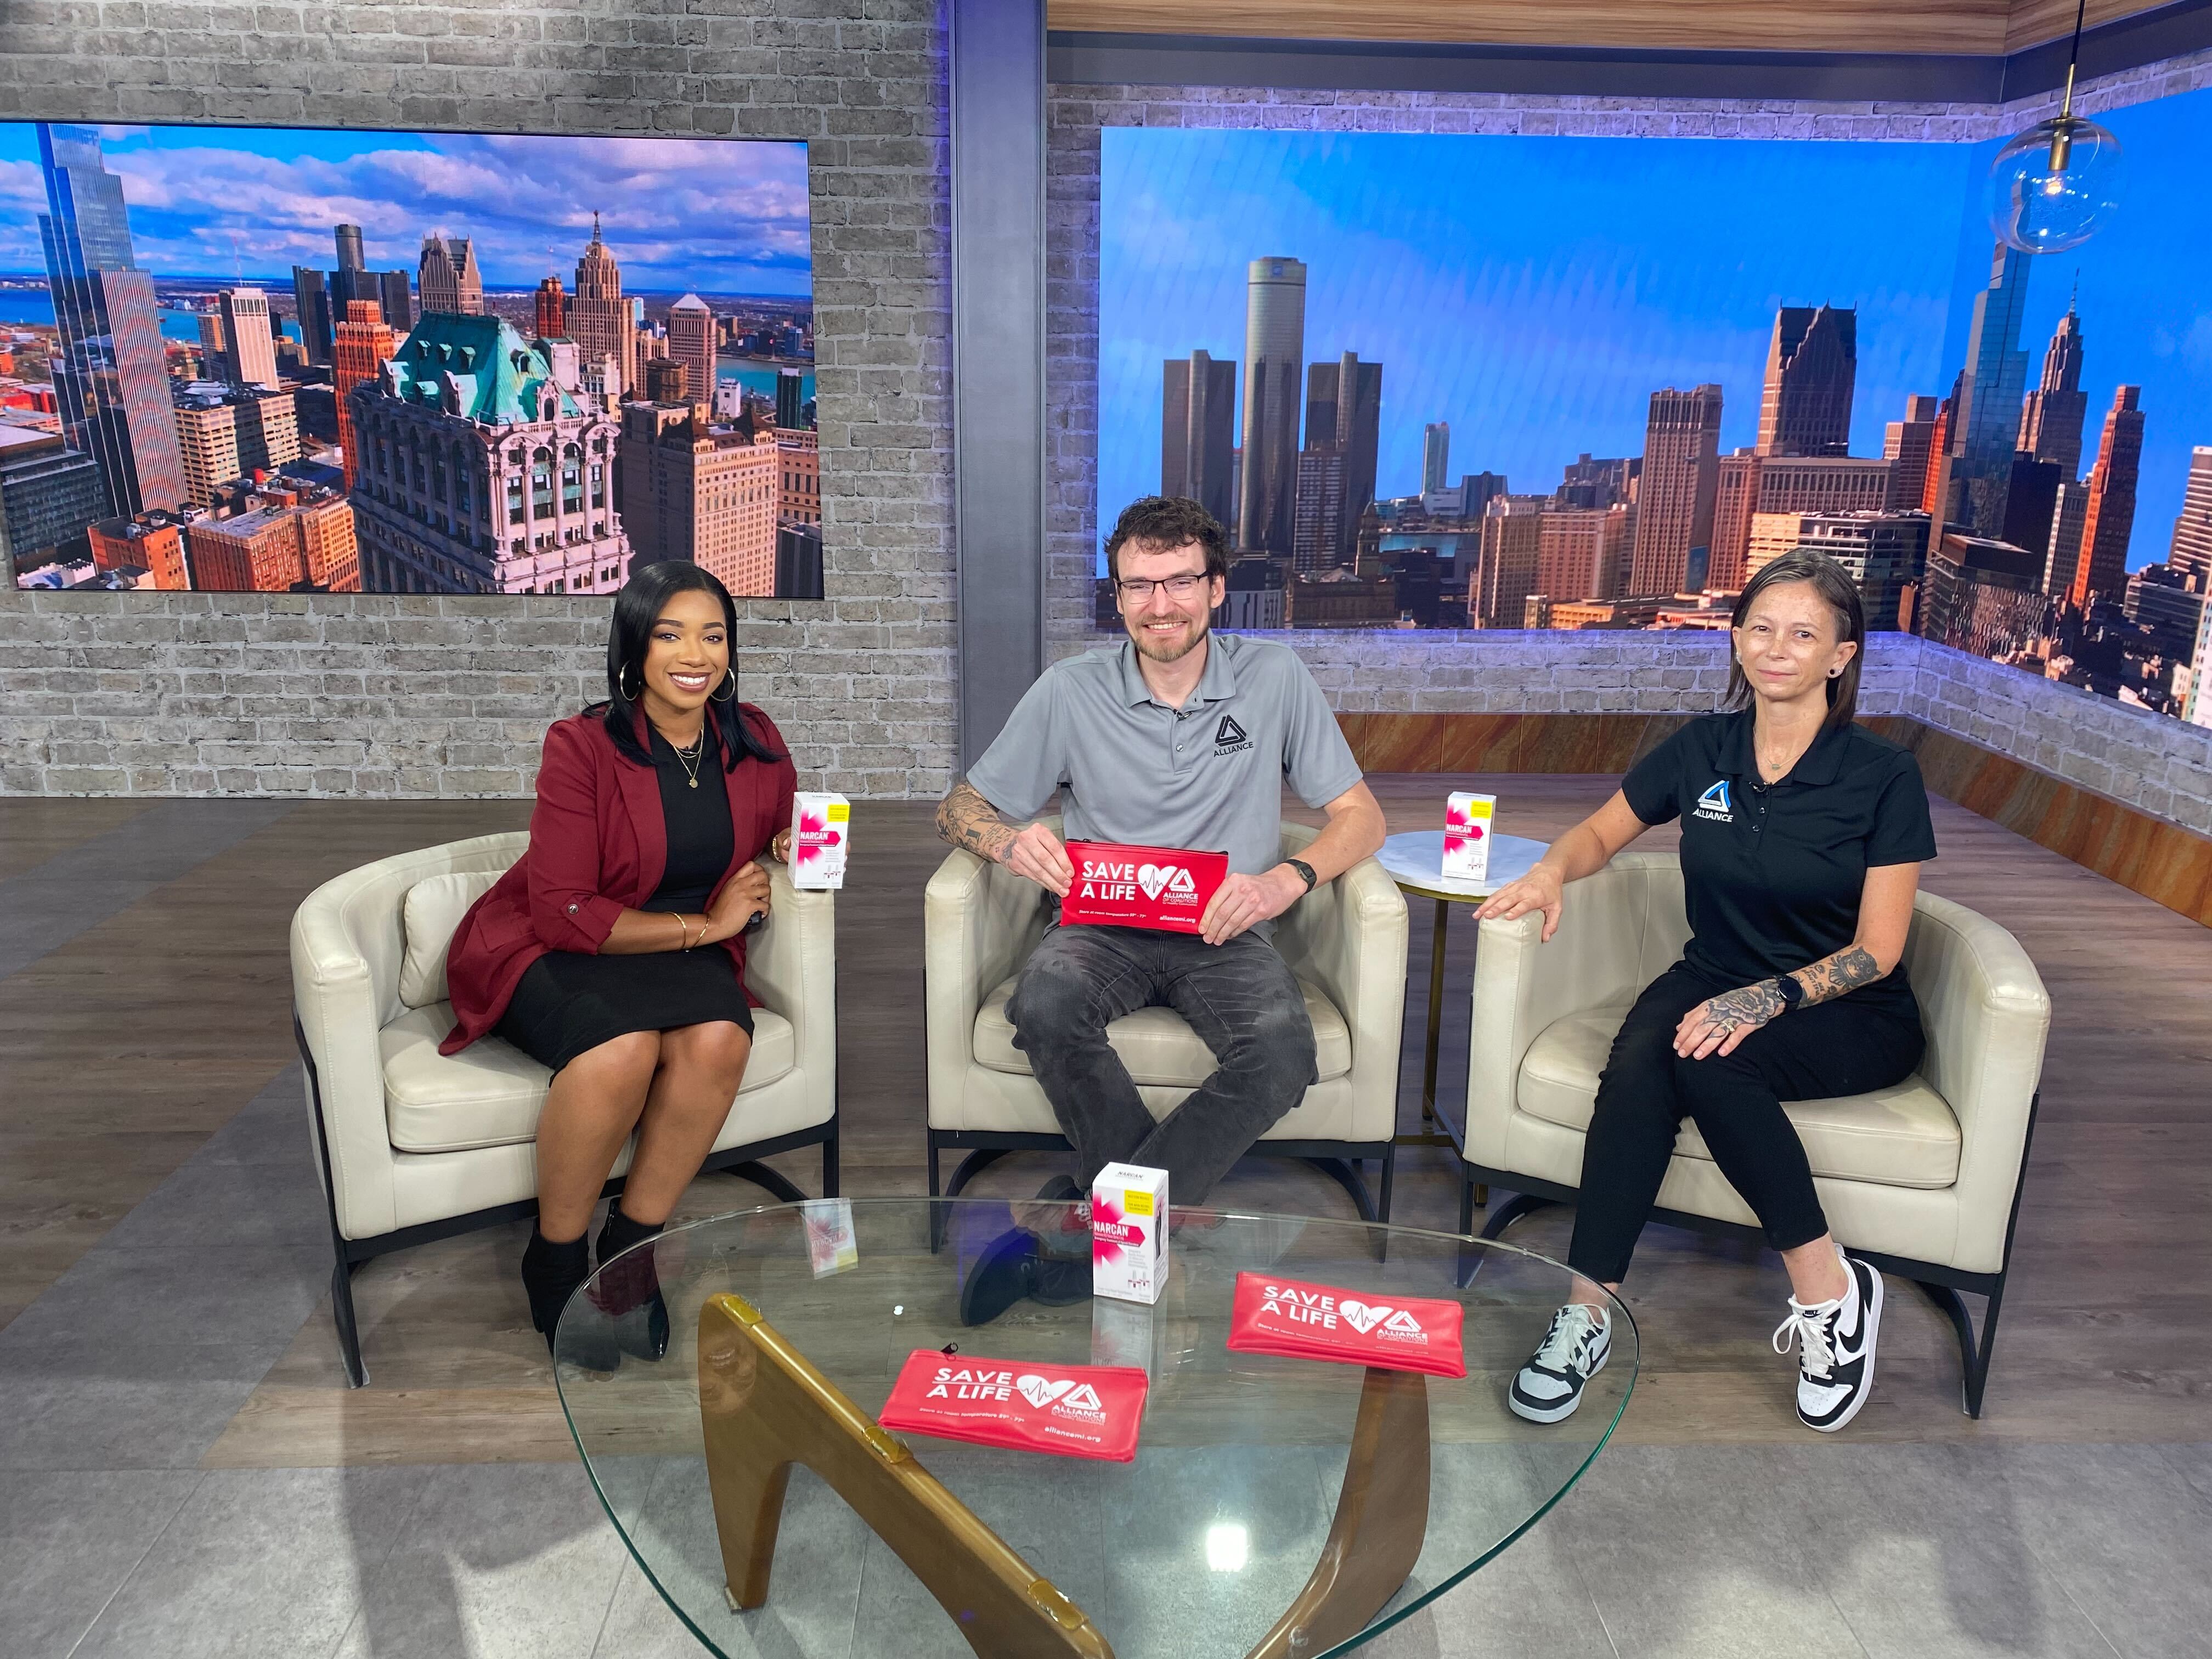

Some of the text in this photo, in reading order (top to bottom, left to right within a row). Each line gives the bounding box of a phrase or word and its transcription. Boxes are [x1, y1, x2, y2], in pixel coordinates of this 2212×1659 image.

[1214, 742, 1254, 757] ALLIANCE
[1692, 808, 1734, 822] ALLIANCE
[800, 831, 828, 840] NARCAN
[1446, 824, 1472, 834] NARCAN
[1082, 861, 1135, 881] SAVE
[1080, 883, 1136, 900] A LIFE
[1159, 915, 1195, 923] alliancemi.org
[1094, 1221, 1128, 1237] NARCAN
[1263, 1285, 1335, 1311] SAVE
[1260, 1300, 1337, 1330] A LIFE
[1377, 1329, 1428, 1339] ALLIANCE
[934, 1368, 1013, 1385] SAVE
[926, 1384, 1012, 1402] A LIFE
[1052, 1405, 1106, 1419] ALLIANCE
[1044, 1426, 1102, 1443] alliancemi.org
